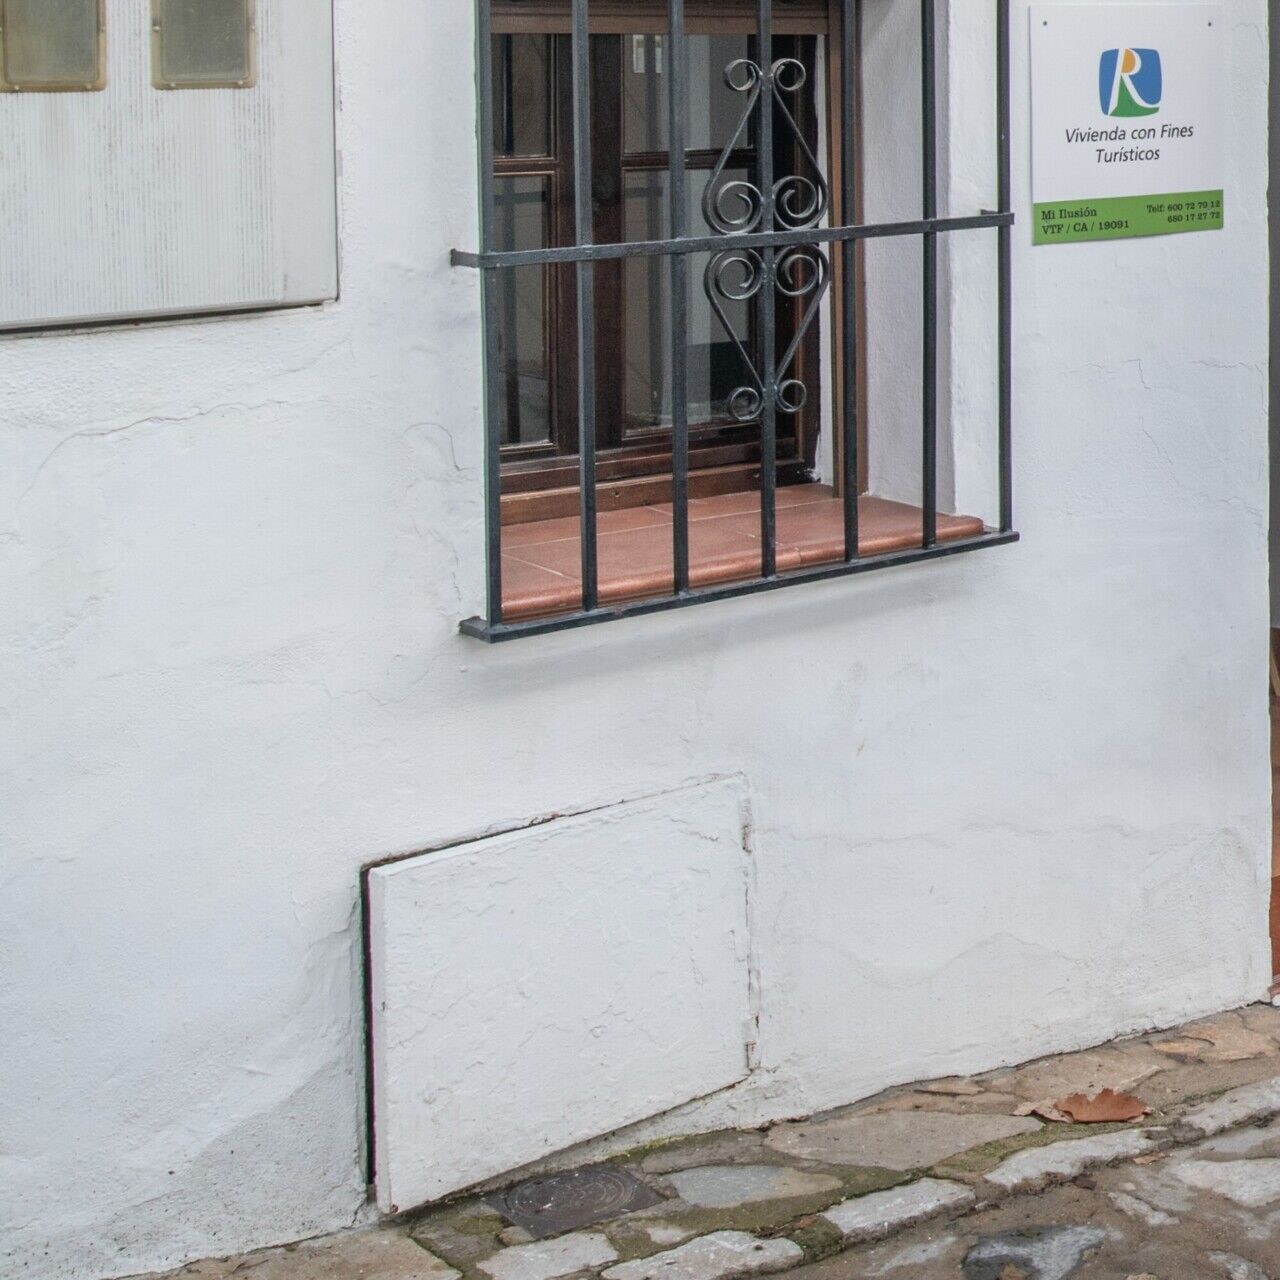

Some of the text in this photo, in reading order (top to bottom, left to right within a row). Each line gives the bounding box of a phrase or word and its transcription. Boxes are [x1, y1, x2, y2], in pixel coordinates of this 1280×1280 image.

[1066, 124, 1194, 143] Vivienda con Fines
[1096, 146, 1160, 163] Turísticos
[1168, 203, 1183, 211] 600
[1211, 200, 1220, 208] 12
[1041, 207, 1097, 220] Mi Ilusión
[1042, 224, 1063, 234] VTF
[1073, 223, 1088, 232] CA
[1099, 220, 1128, 230] 19091
